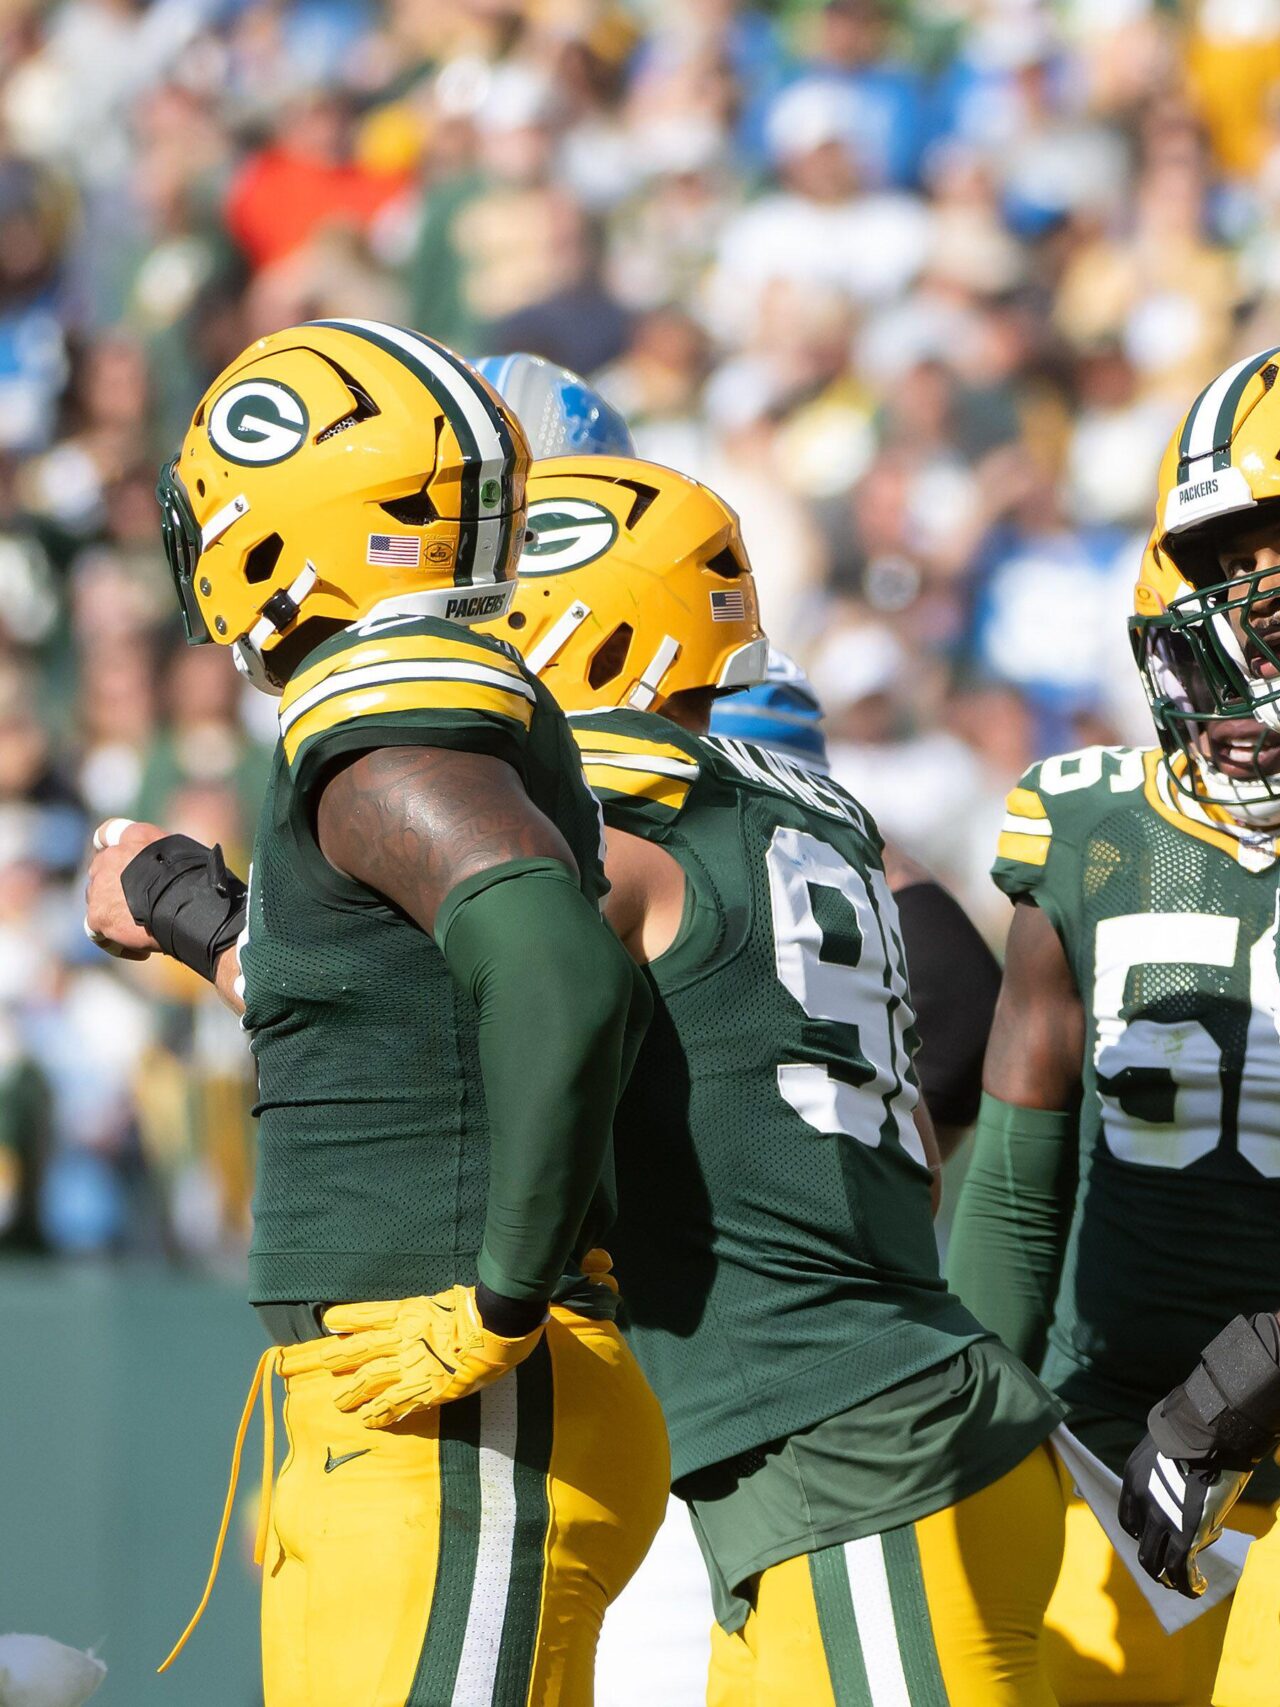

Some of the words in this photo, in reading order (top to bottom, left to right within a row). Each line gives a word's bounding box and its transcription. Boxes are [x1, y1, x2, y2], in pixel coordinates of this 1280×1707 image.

[209, 381, 307, 464] G
[1179, 478, 1219, 505] PACKERS
[445, 593, 506, 618] PACKERS
